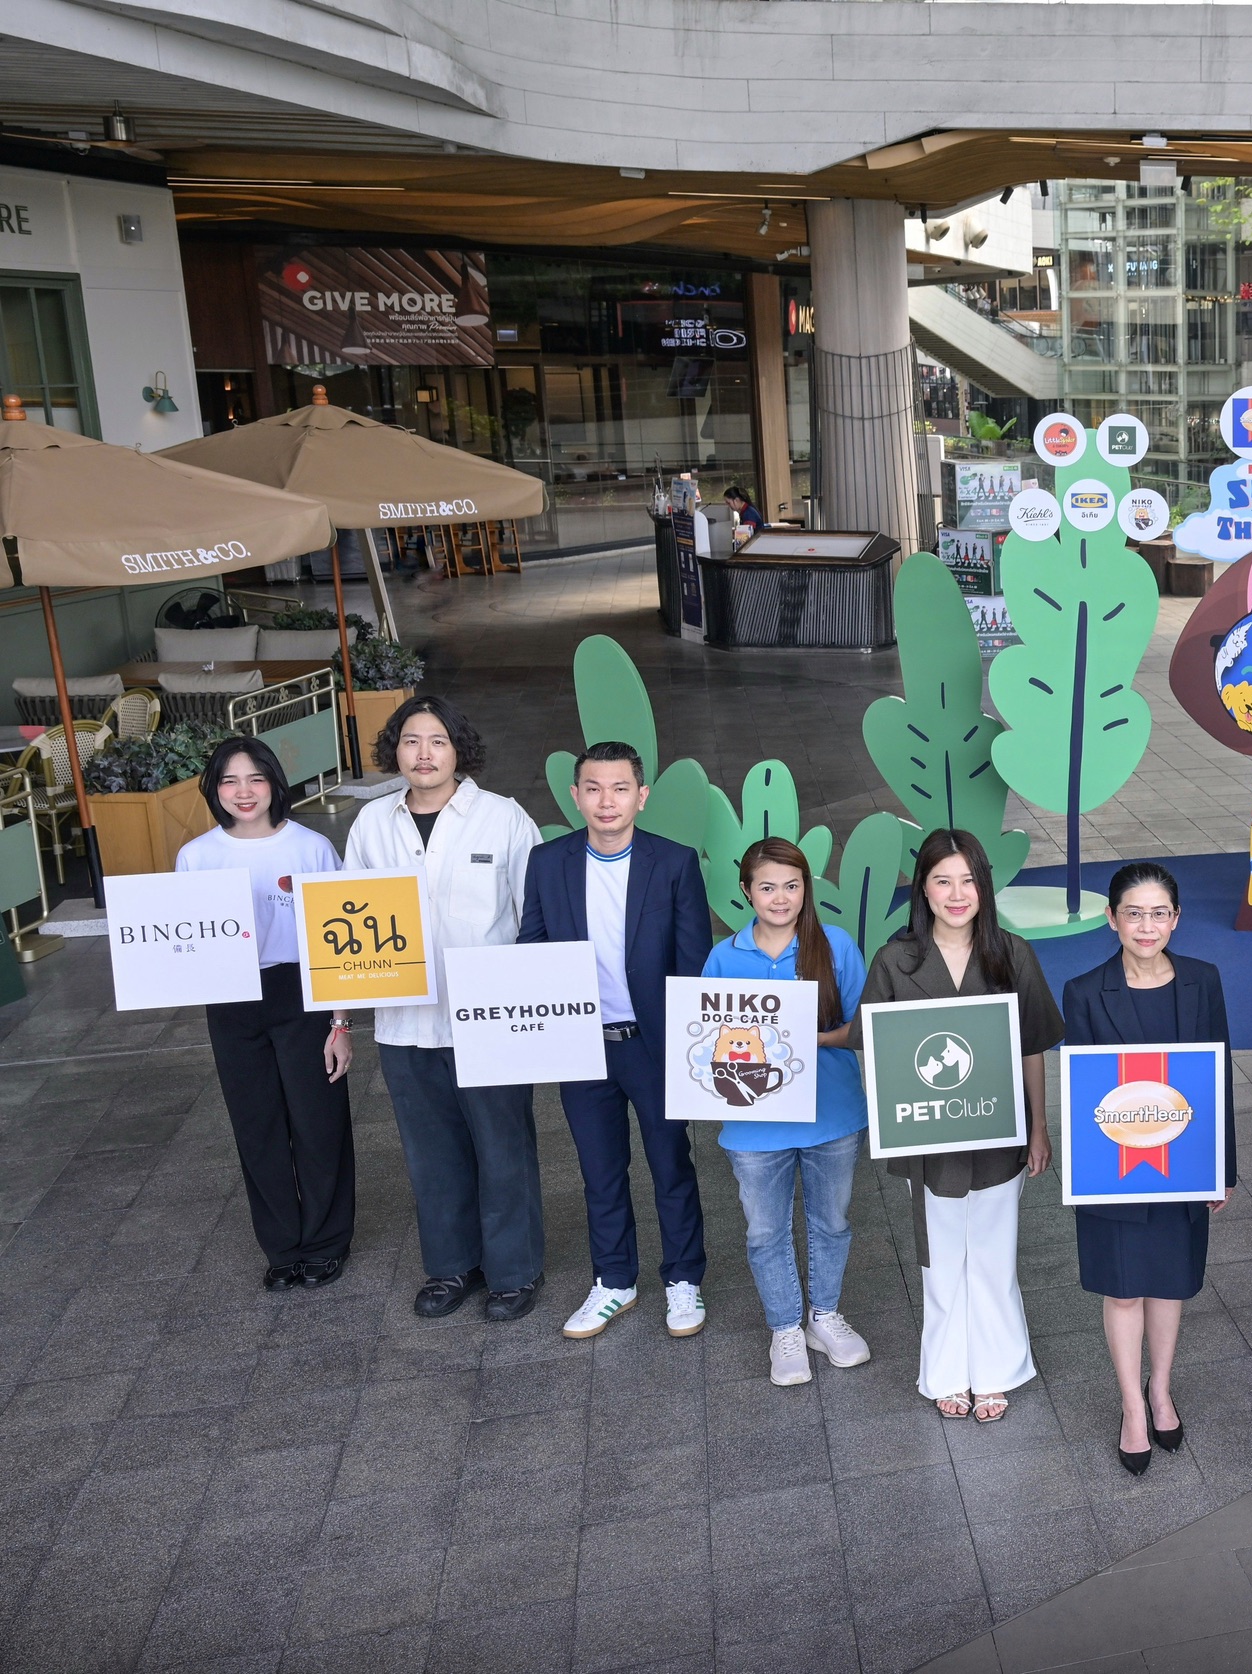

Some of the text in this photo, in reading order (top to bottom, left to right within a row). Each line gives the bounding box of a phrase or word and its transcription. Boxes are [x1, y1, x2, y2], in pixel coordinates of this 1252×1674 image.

[302, 290, 456, 313] GIVE MORE
[1017, 507, 1054, 520] Kiehl's
[322, 900, 407, 956] ฉัน
[342, 959, 392, 972] CHUNN
[338, 973, 353, 981] MEAT
[368, 971, 399, 980] DELICIOUS
[700, 992, 782, 1014] NIKO
[455, 1001, 597, 1022] GREYHOUND
[701, 1013, 780, 1025] DOG CAFÉ
[510, 1021, 545, 1033] CAFÉ
[738, 1067, 766, 1077] Grooming
[1093, 1105, 1194, 1125] SmartHeart
